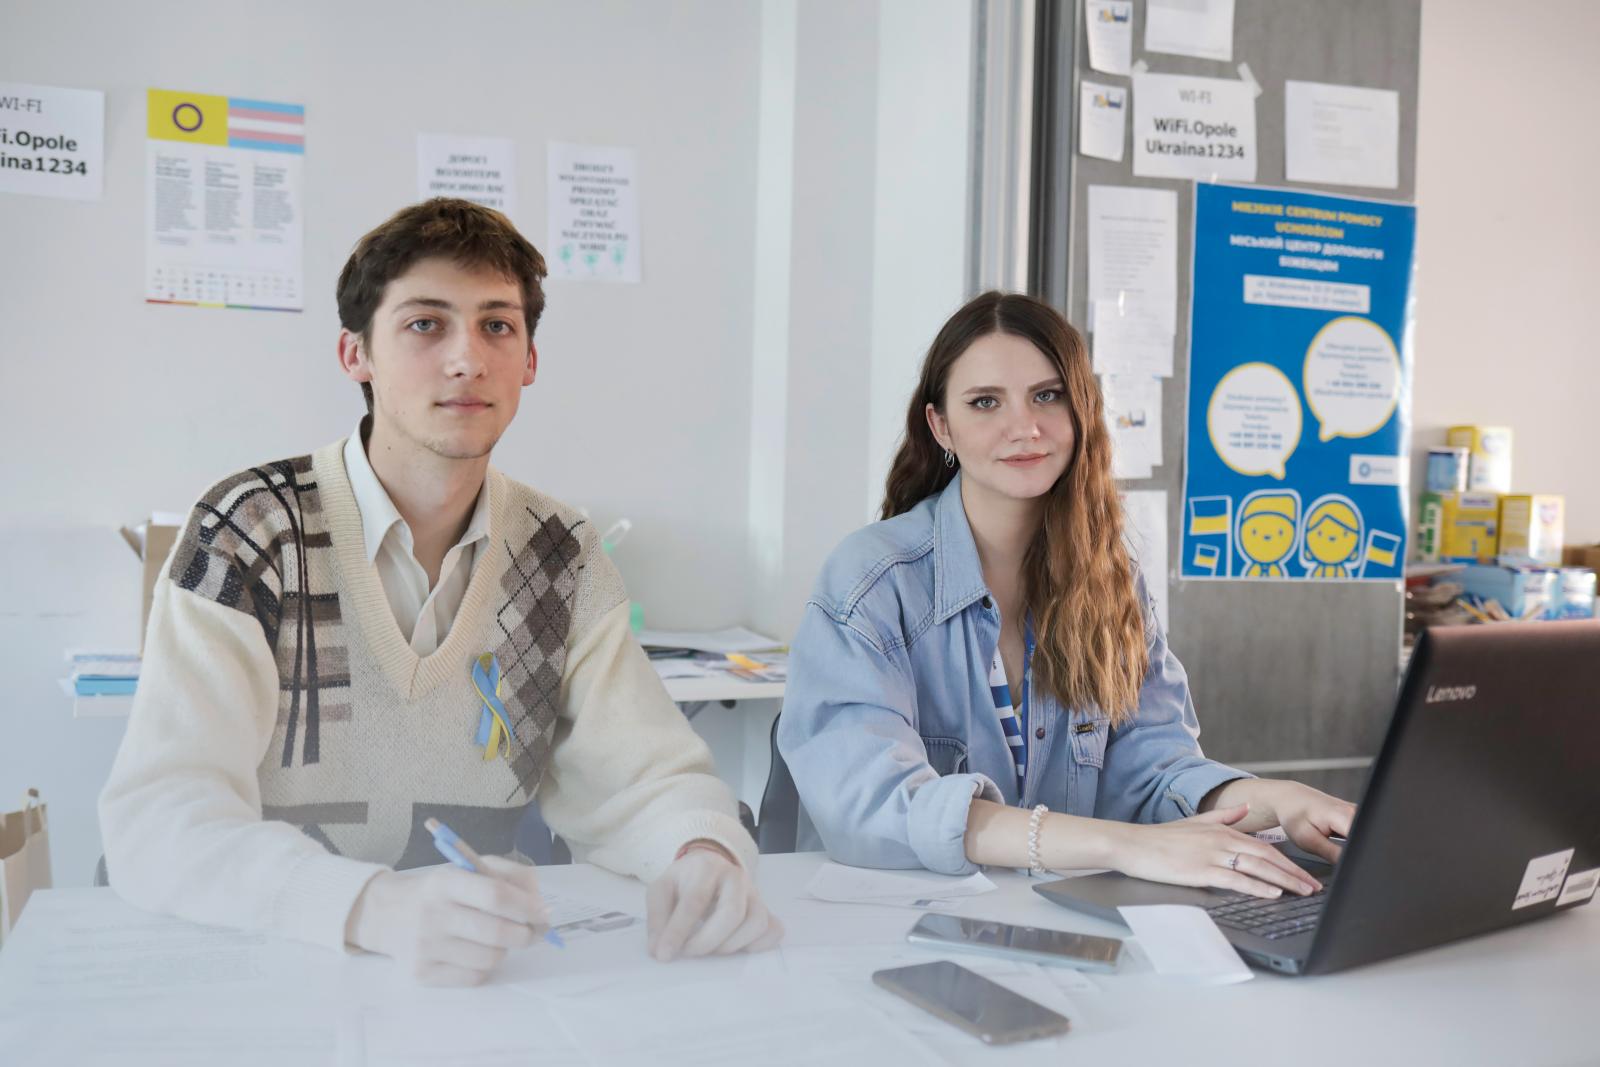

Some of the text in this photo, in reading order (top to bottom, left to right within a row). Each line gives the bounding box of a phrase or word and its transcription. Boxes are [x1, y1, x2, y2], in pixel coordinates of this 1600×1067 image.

[1178, 89, 1212, 104] WI-FI
[1154, 117, 1237, 138] WiFi.Opole
[0, 128, 77, 152] i.Opole
[1146, 139, 1245, 159] Ukraina1234
[1286, 205, 1337, 221] CENTRUM
[1426, 685, 1477, 703] Lenovo
